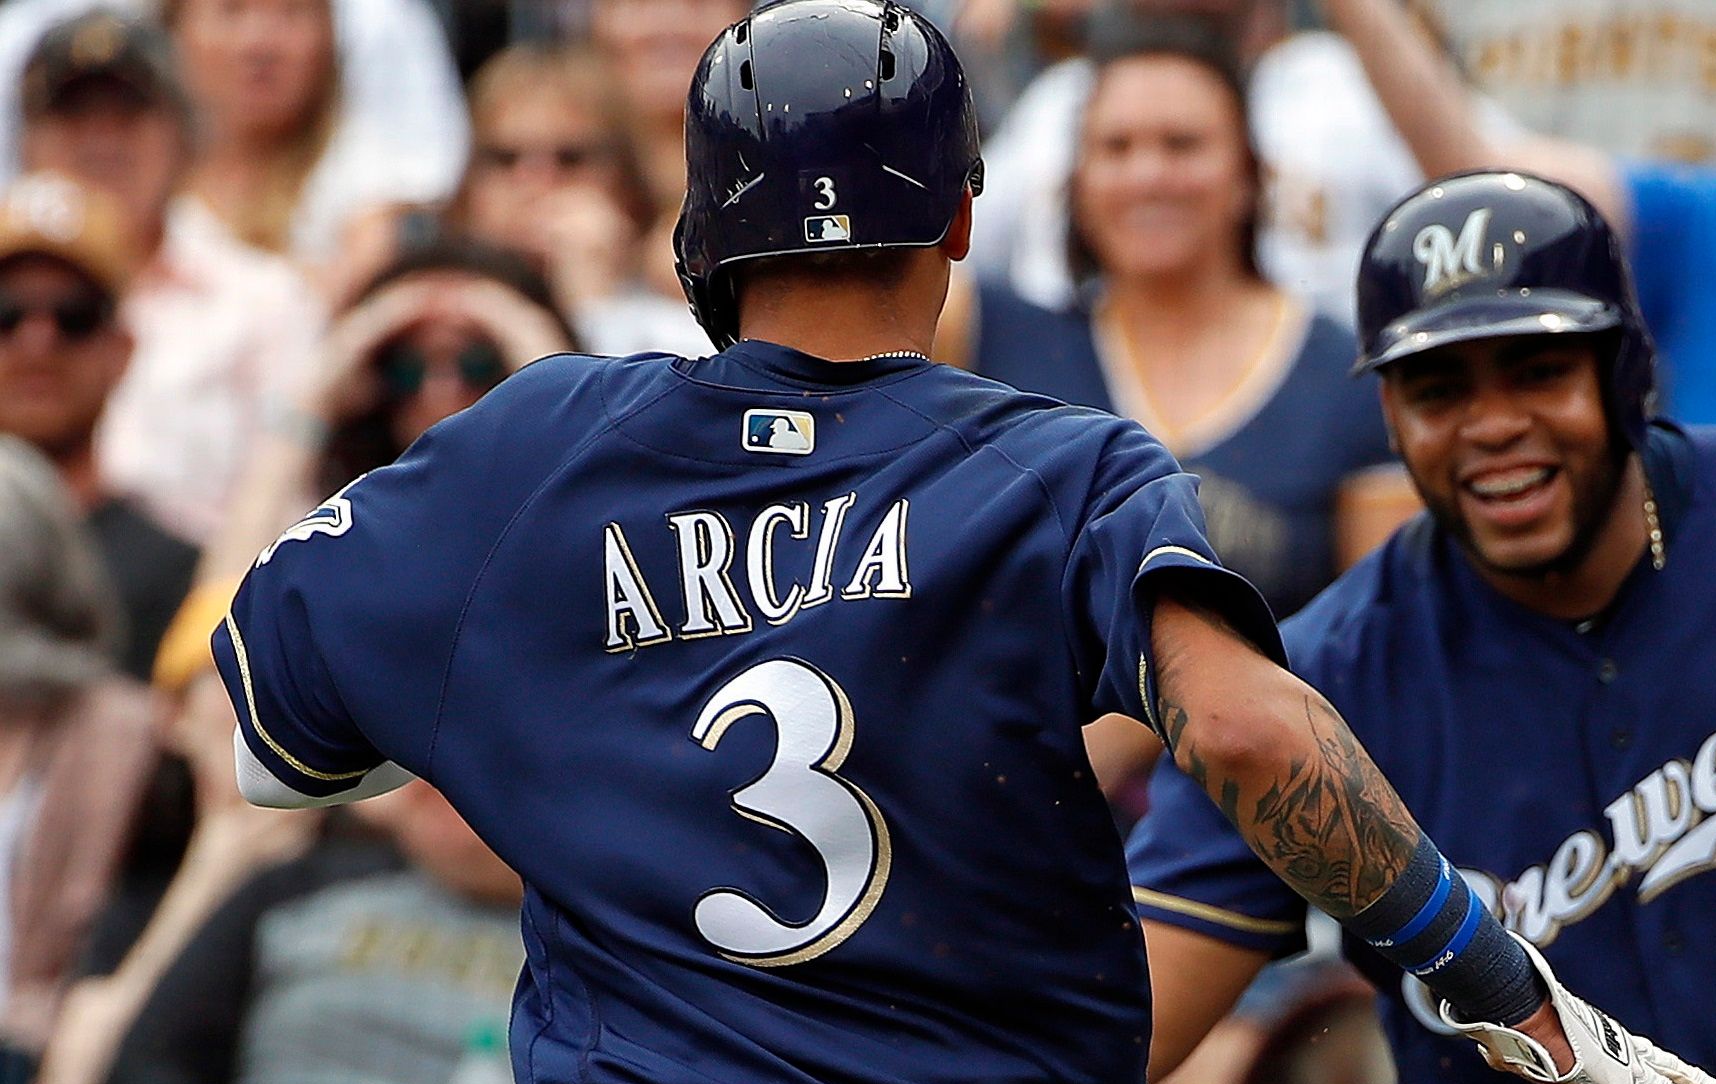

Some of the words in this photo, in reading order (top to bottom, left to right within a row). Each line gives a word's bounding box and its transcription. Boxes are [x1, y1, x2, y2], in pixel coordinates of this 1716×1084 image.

[813, 176, 837, 210] 3
[1413, 207, 1493, 297] M
[603, 490, 913, 654] ARCIA
[688, 654, 893, 968] 3
